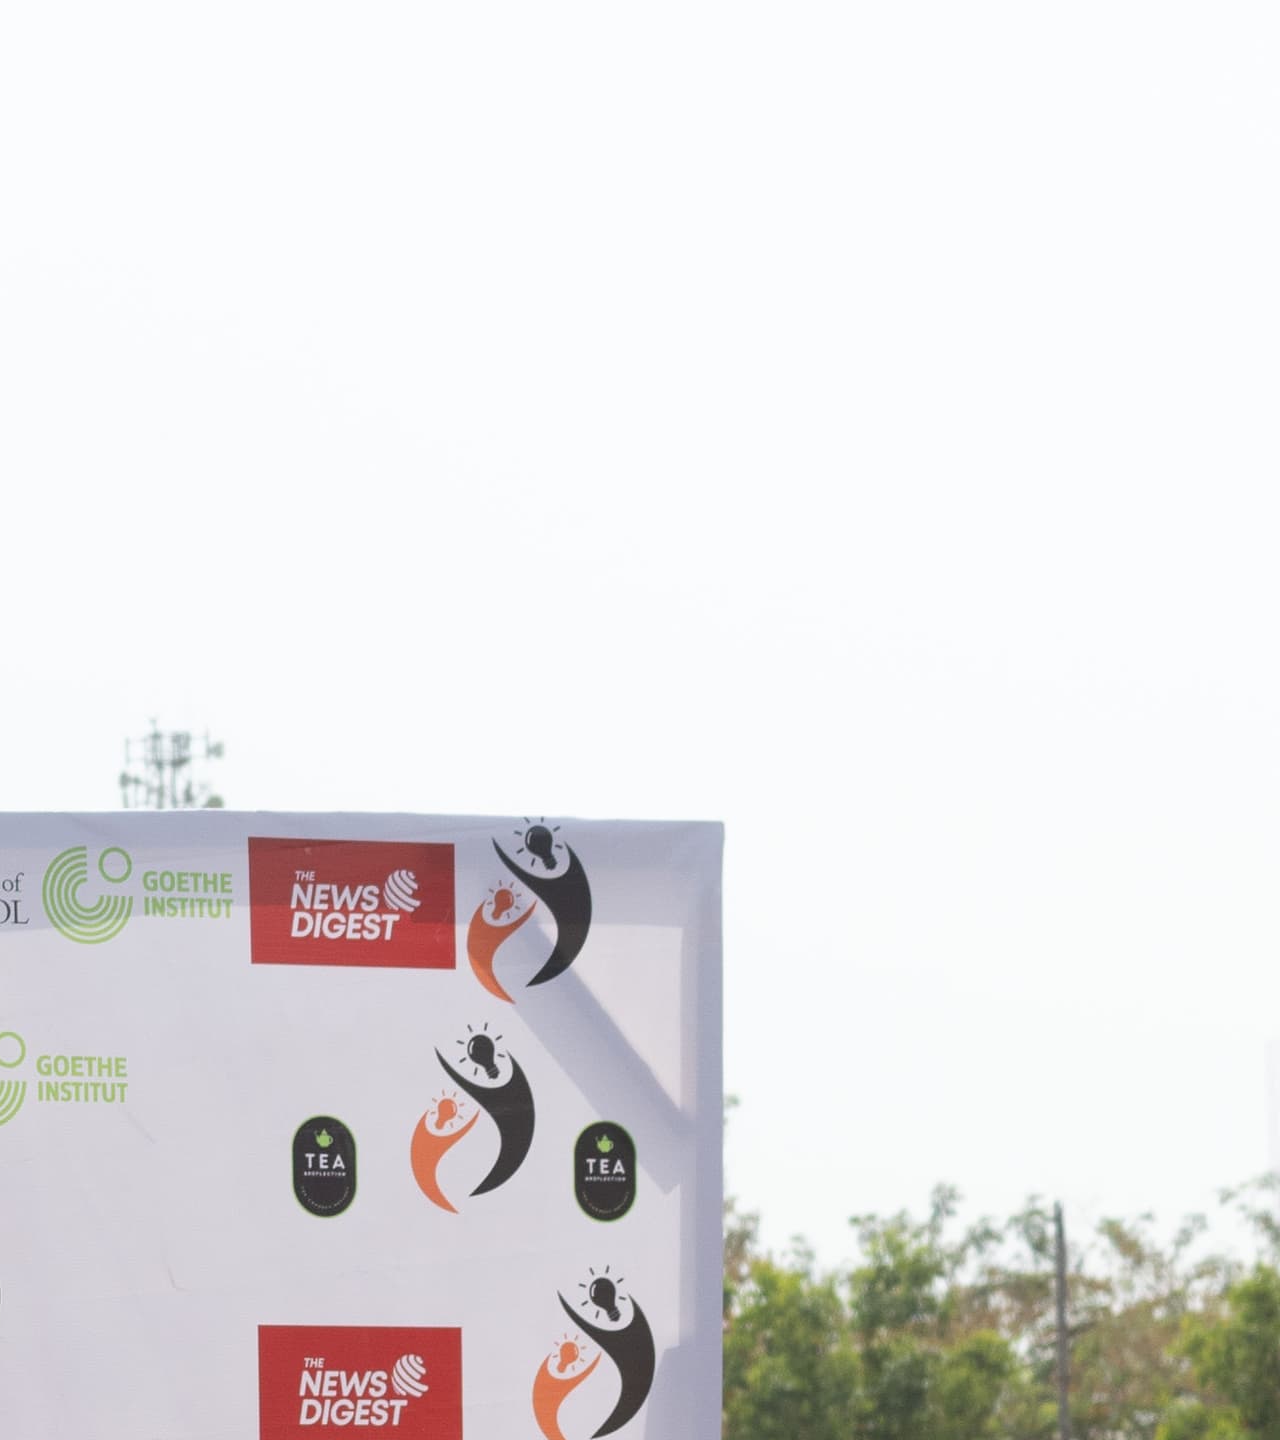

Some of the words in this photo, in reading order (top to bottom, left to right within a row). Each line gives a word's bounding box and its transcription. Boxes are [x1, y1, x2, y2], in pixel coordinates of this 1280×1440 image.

[2, 873, 24, 891] of
[142, 871, 232, 893] GOETHE
[296, 872, 314, 880] THE
[144, 896, 233, 919] INSTITUT
[291, 884, 380, 911] NEWS
[292, 912, 400, 940] DIGEST
[36, 1055, 127, 1077] GOETHE
[38, 1081, 128, 1103] INSTITUT
[305, 1153, 345, 1169] TEA
[586, 1159, 625, 1174] TEA
[305, 1358, 324, 1367] THE
[300, 1370, 387, 1397] NEWS
[300, 1399, 407, 1425] DIGEST
